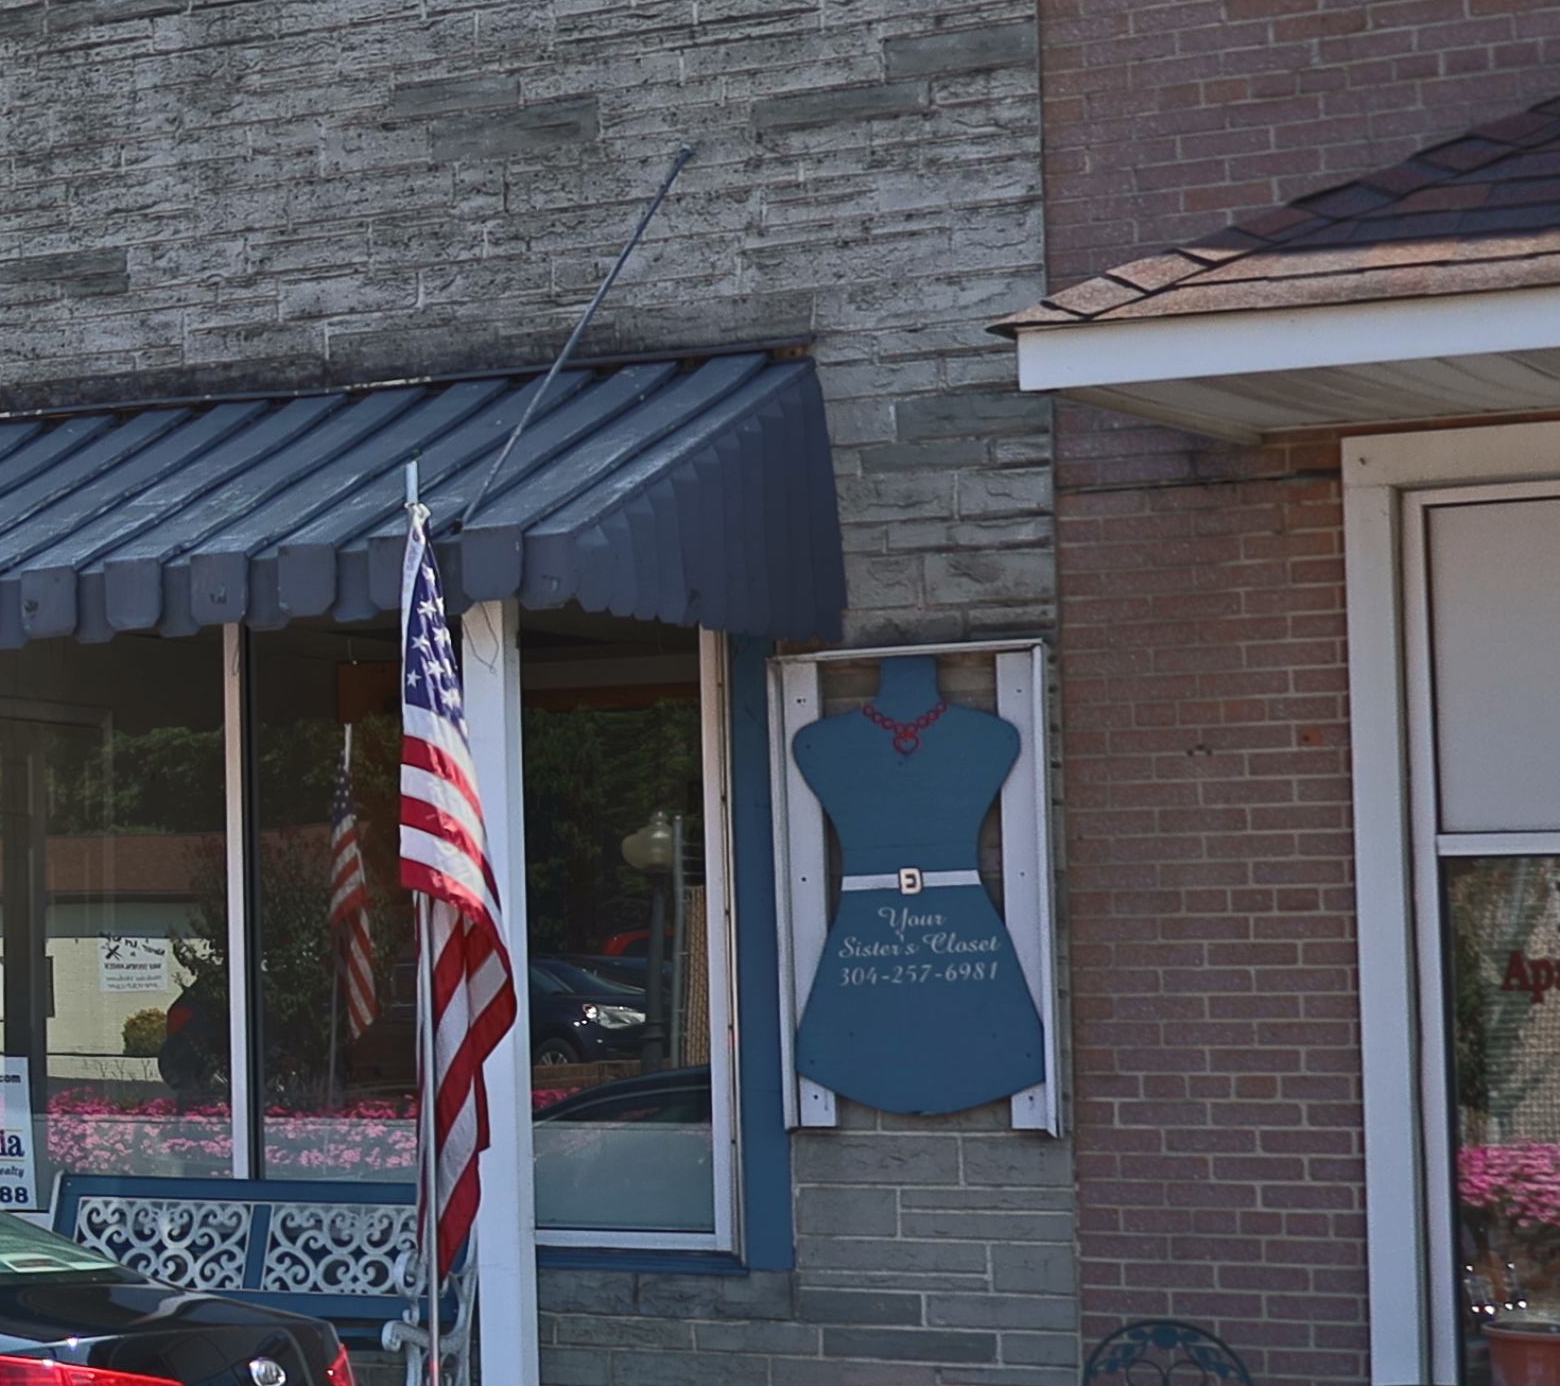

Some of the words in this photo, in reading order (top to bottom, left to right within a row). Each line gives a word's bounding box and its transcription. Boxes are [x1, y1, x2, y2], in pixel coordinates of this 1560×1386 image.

[877, 906, 947, 931] Your
[838, 928, 919, 959] Sister's
[922, 931, 1001, 955] Closet
[838, 961, 999, 987] 304-257-6981
